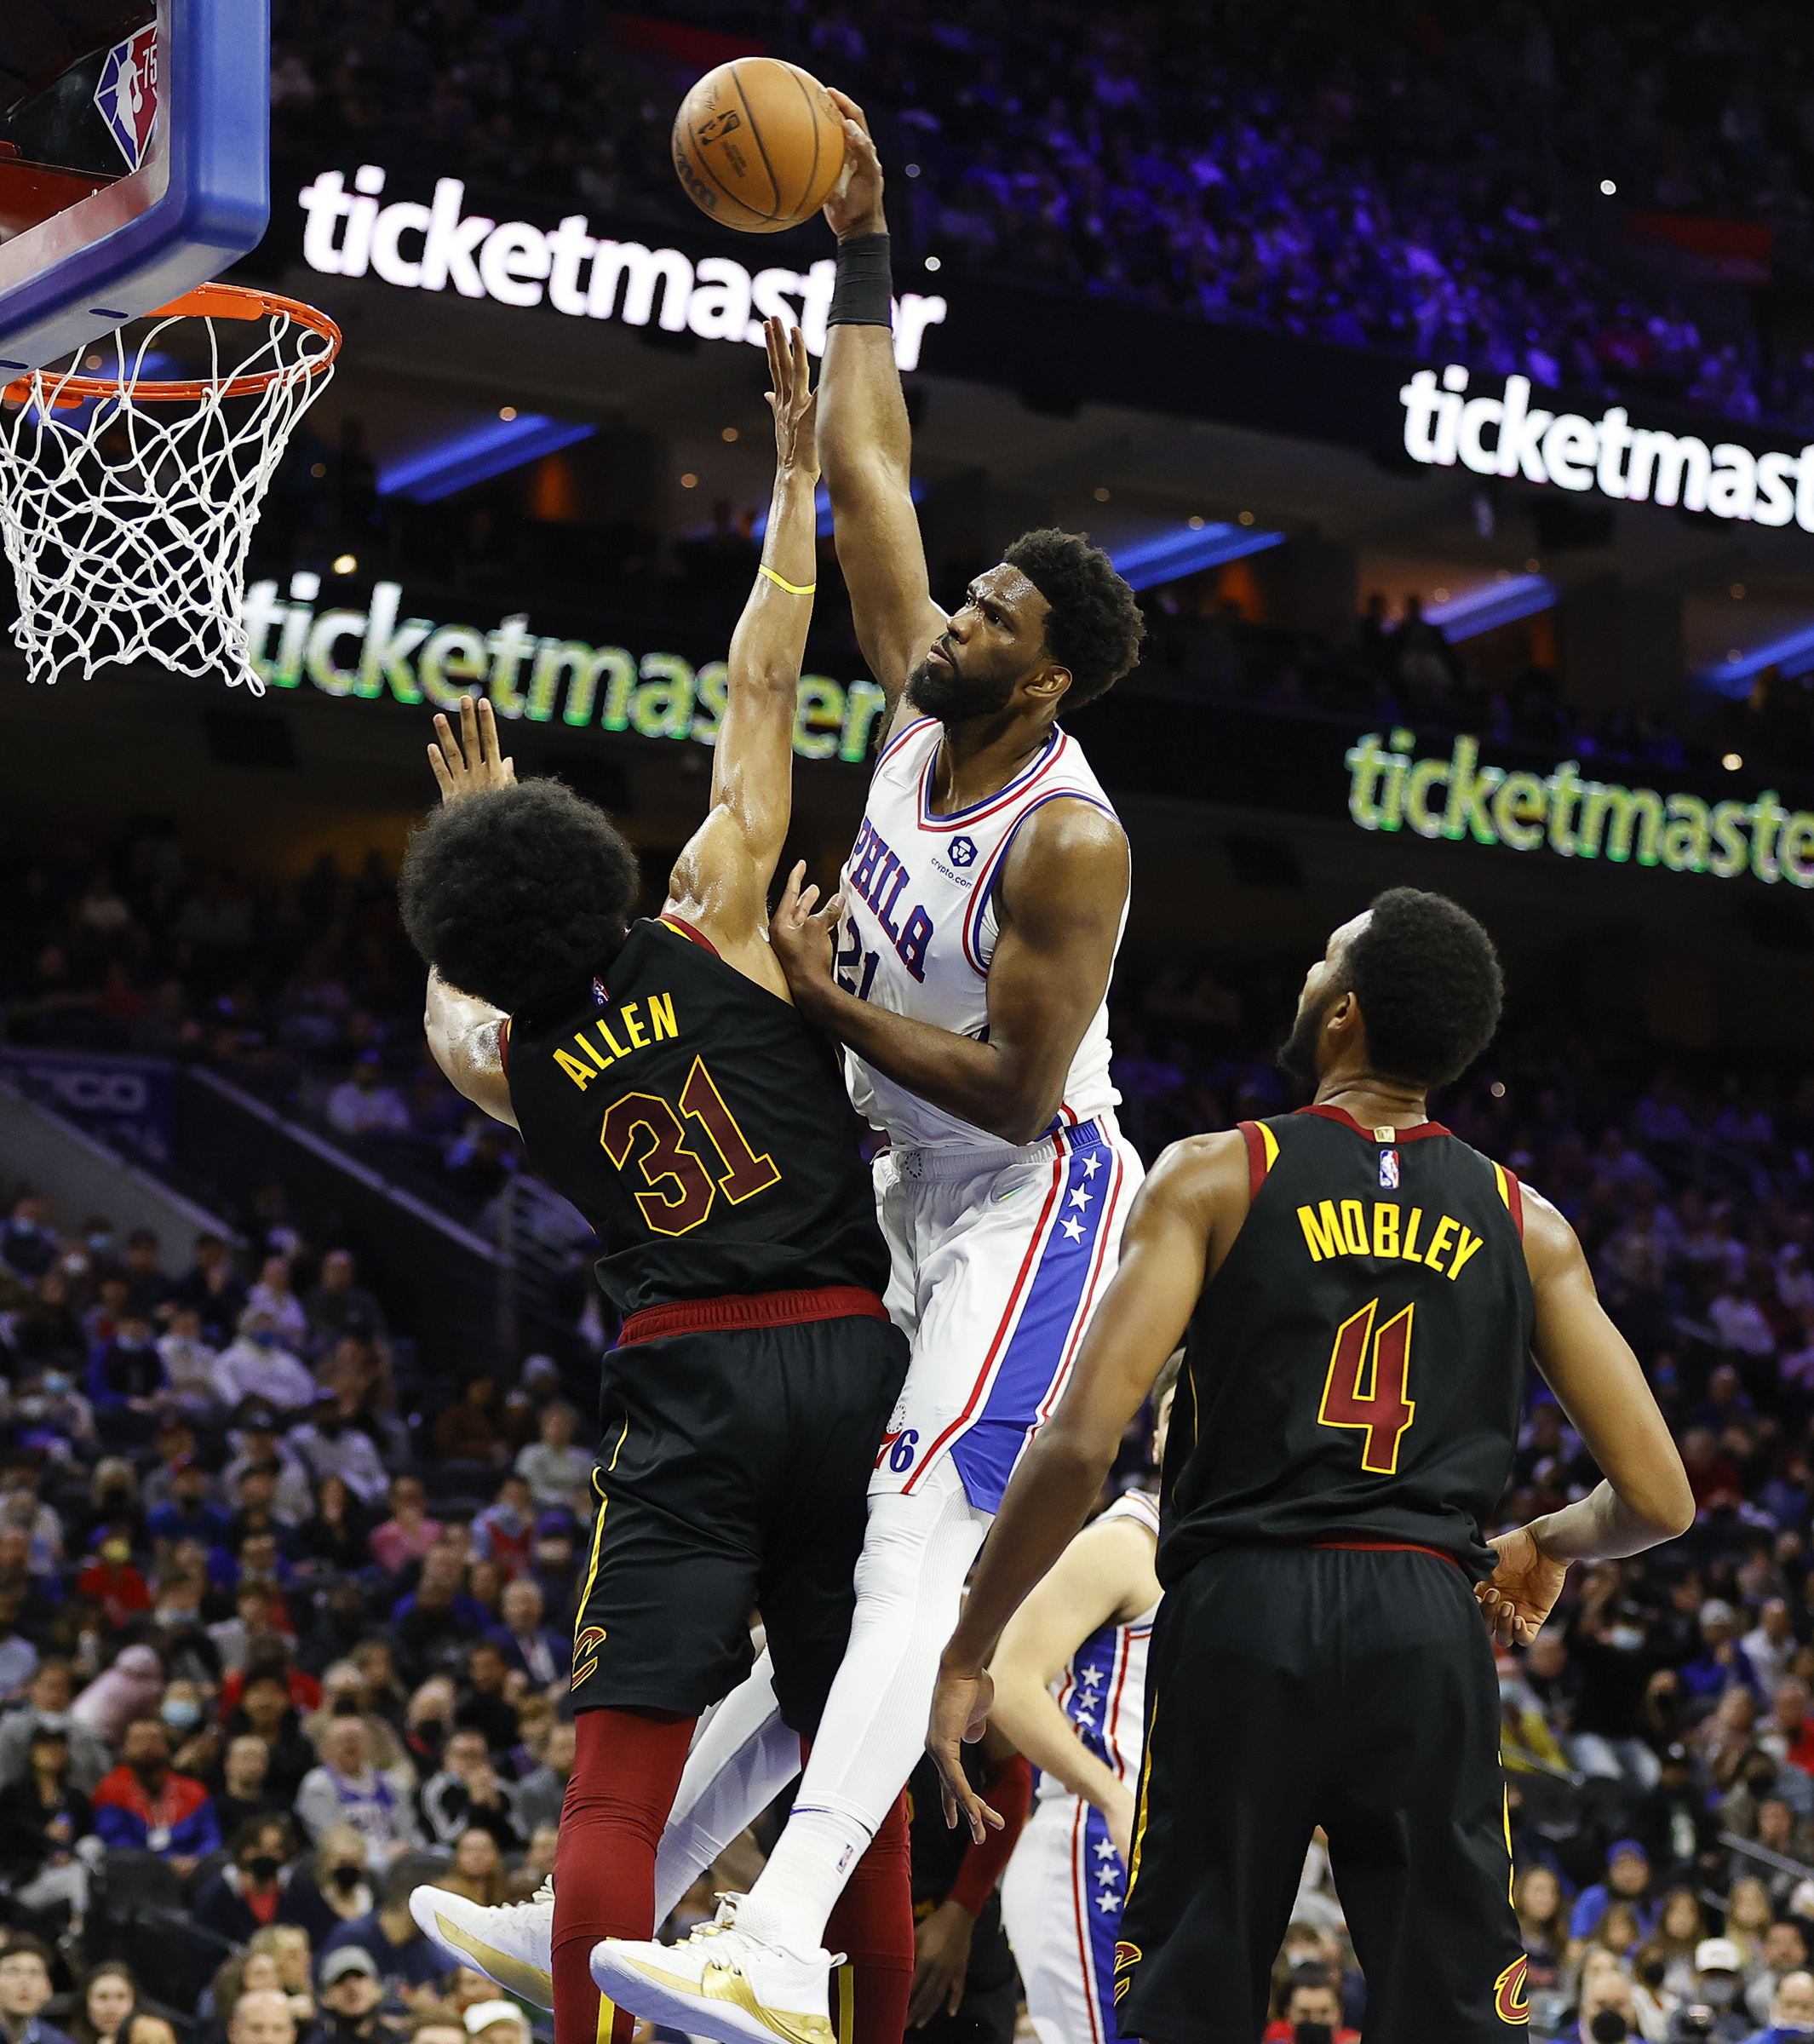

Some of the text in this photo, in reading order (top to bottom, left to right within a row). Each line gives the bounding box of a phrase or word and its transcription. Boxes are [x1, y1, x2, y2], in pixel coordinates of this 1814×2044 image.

[299, 164, 947, 372] ticketmastr
[242, 571, 887, 763] ticketmaser
[837, 916, 881, 1002] 21
[847, 816, 934, 984] PHILA
[553, 992, 680, 1092] ALLEN
[600, 1054, 782, 1237] 31
[1296, 1198, 1484, 1282] MOBLEY
[1317, 1297, 1415, 1475] 4
